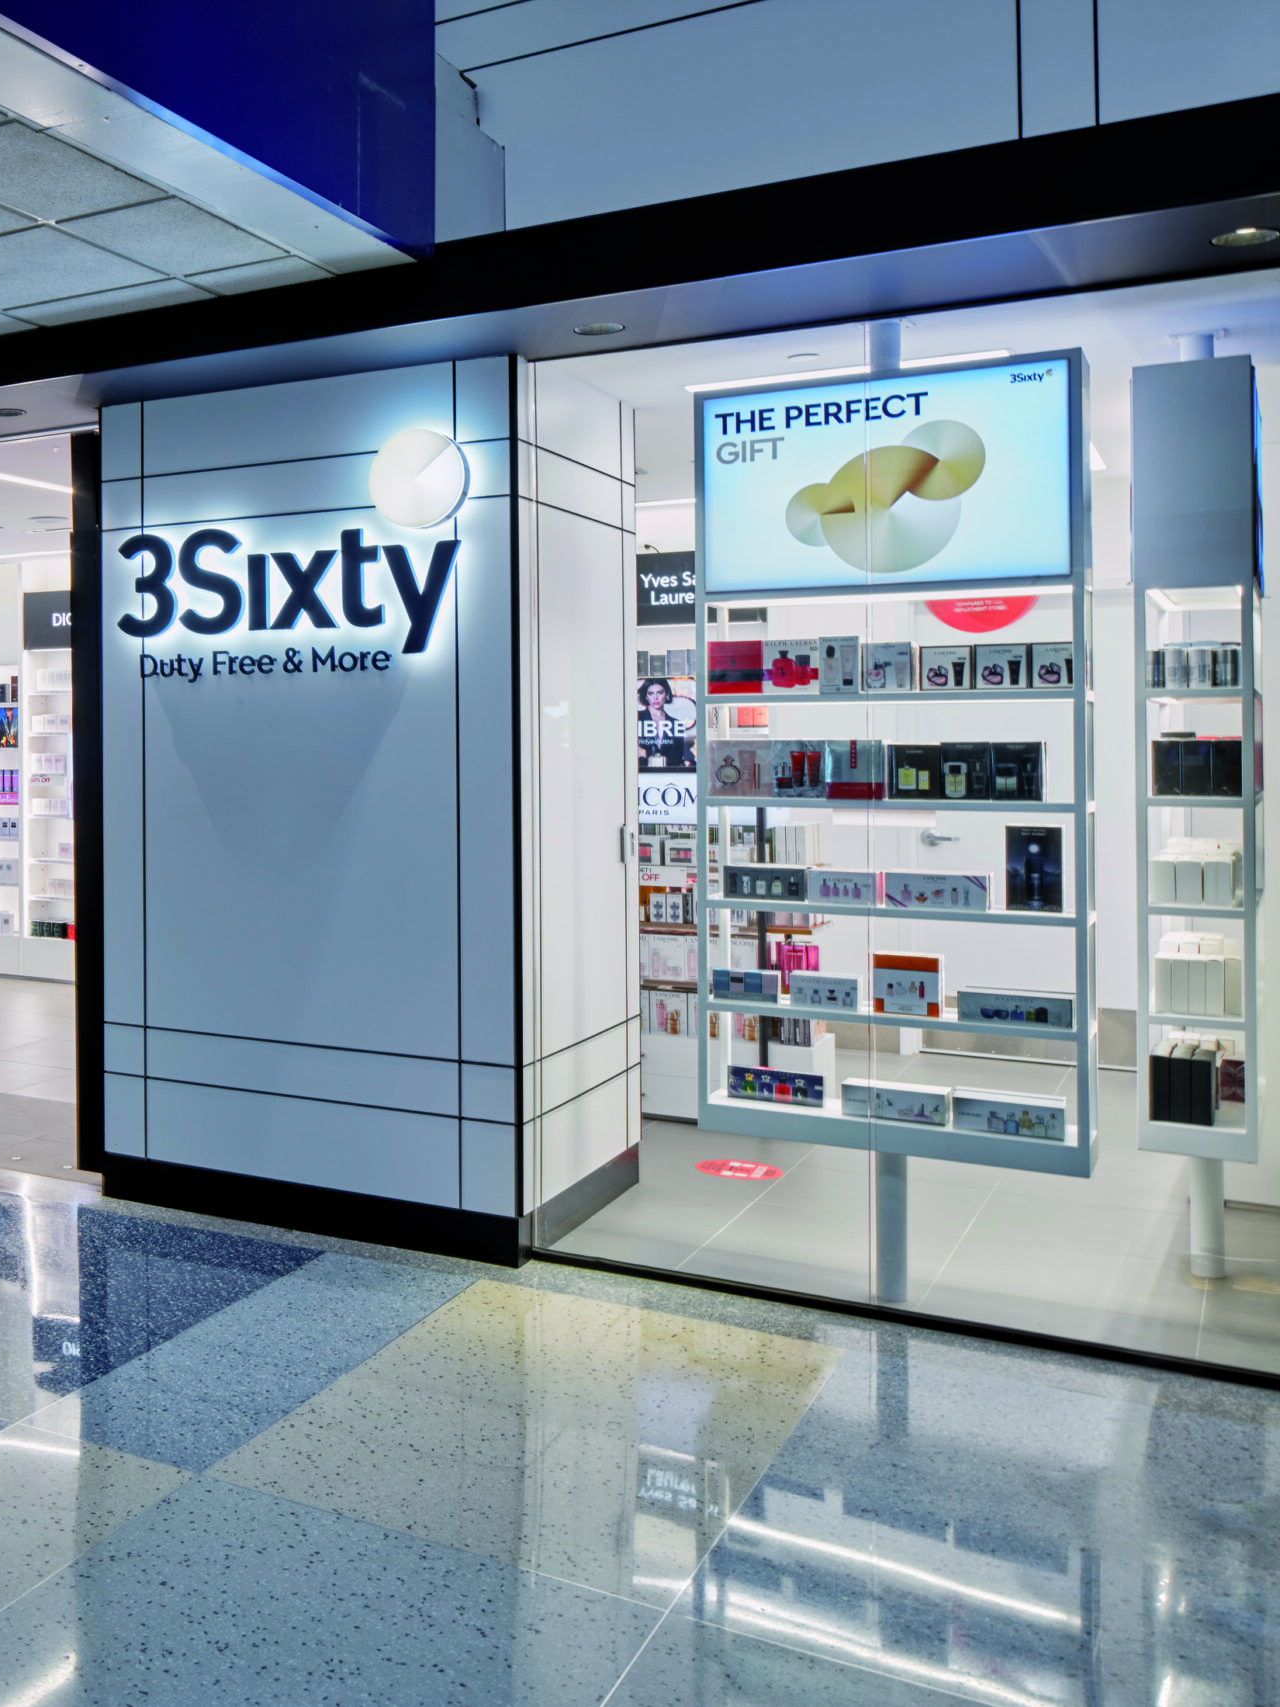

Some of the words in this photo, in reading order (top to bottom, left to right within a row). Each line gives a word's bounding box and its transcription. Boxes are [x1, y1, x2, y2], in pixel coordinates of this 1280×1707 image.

[1010, 371, 1045, 384] 3Sixty
[715, 407, 776, 435] THE
[784, 391, 929, 429] PERFECT
[716, 436, 785, 465] GIFT
[116, 528, 462, 654] 3Sixty
[640, 573, 678, 588] Yves
[139, 653, 204, 684] Duty
[212, 650, 277, 676] Free
[282, 647, 303, 673] &
[311, 645, 392, 672] More
[641, 873, 660, 881] OFF
